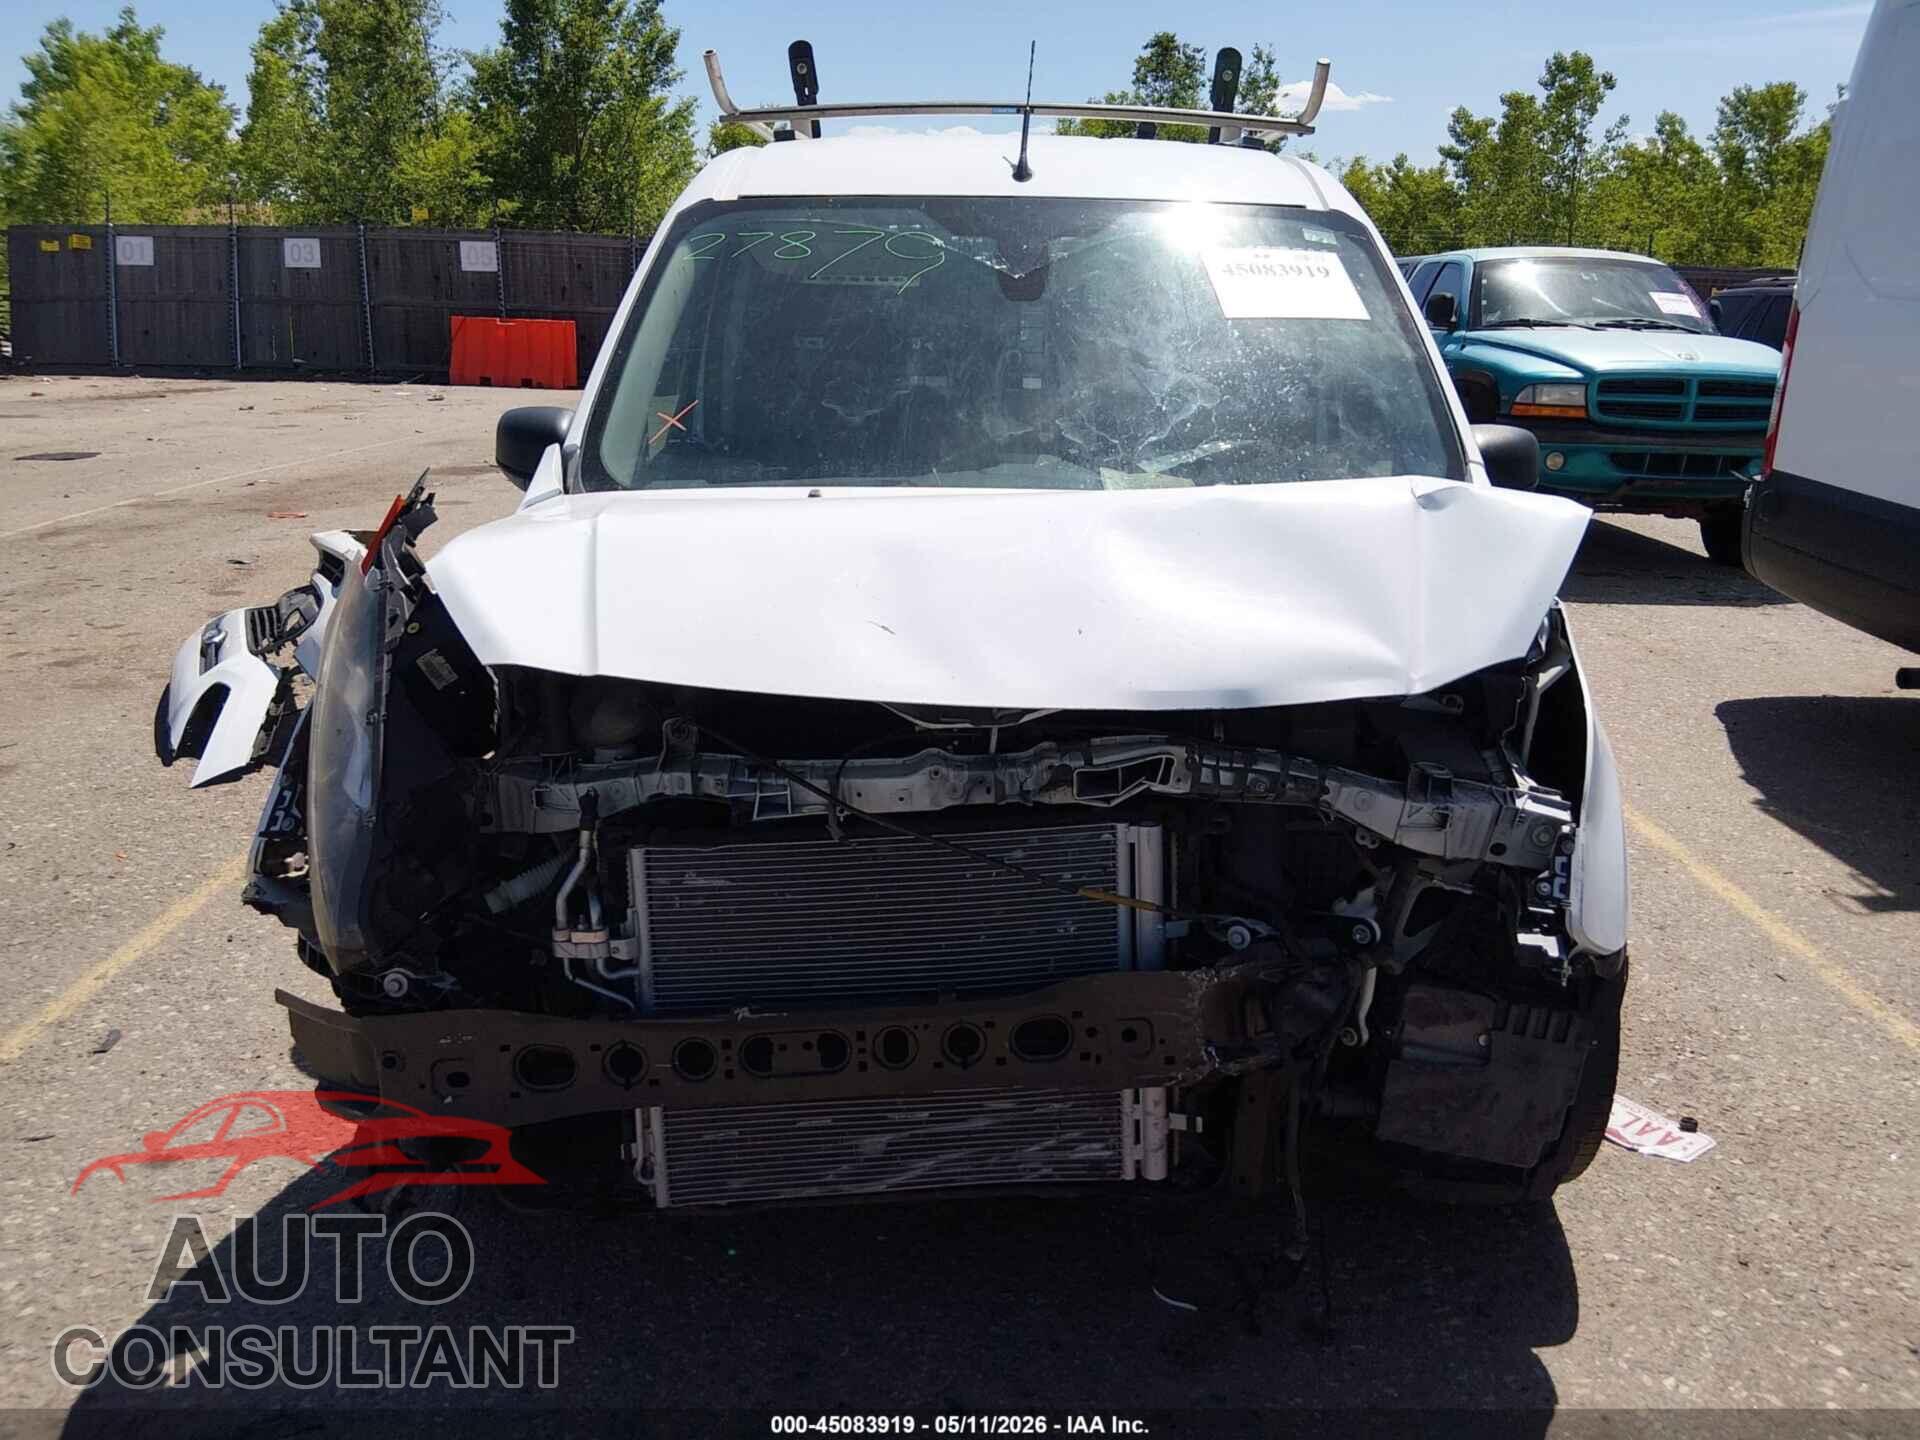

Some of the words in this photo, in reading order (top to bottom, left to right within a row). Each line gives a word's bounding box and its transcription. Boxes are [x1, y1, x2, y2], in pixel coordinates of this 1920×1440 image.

[290, 243, 315, 263] 03
[466, 246, 493, 266] 05
[1221, 262, 1331, 279] 45083919
